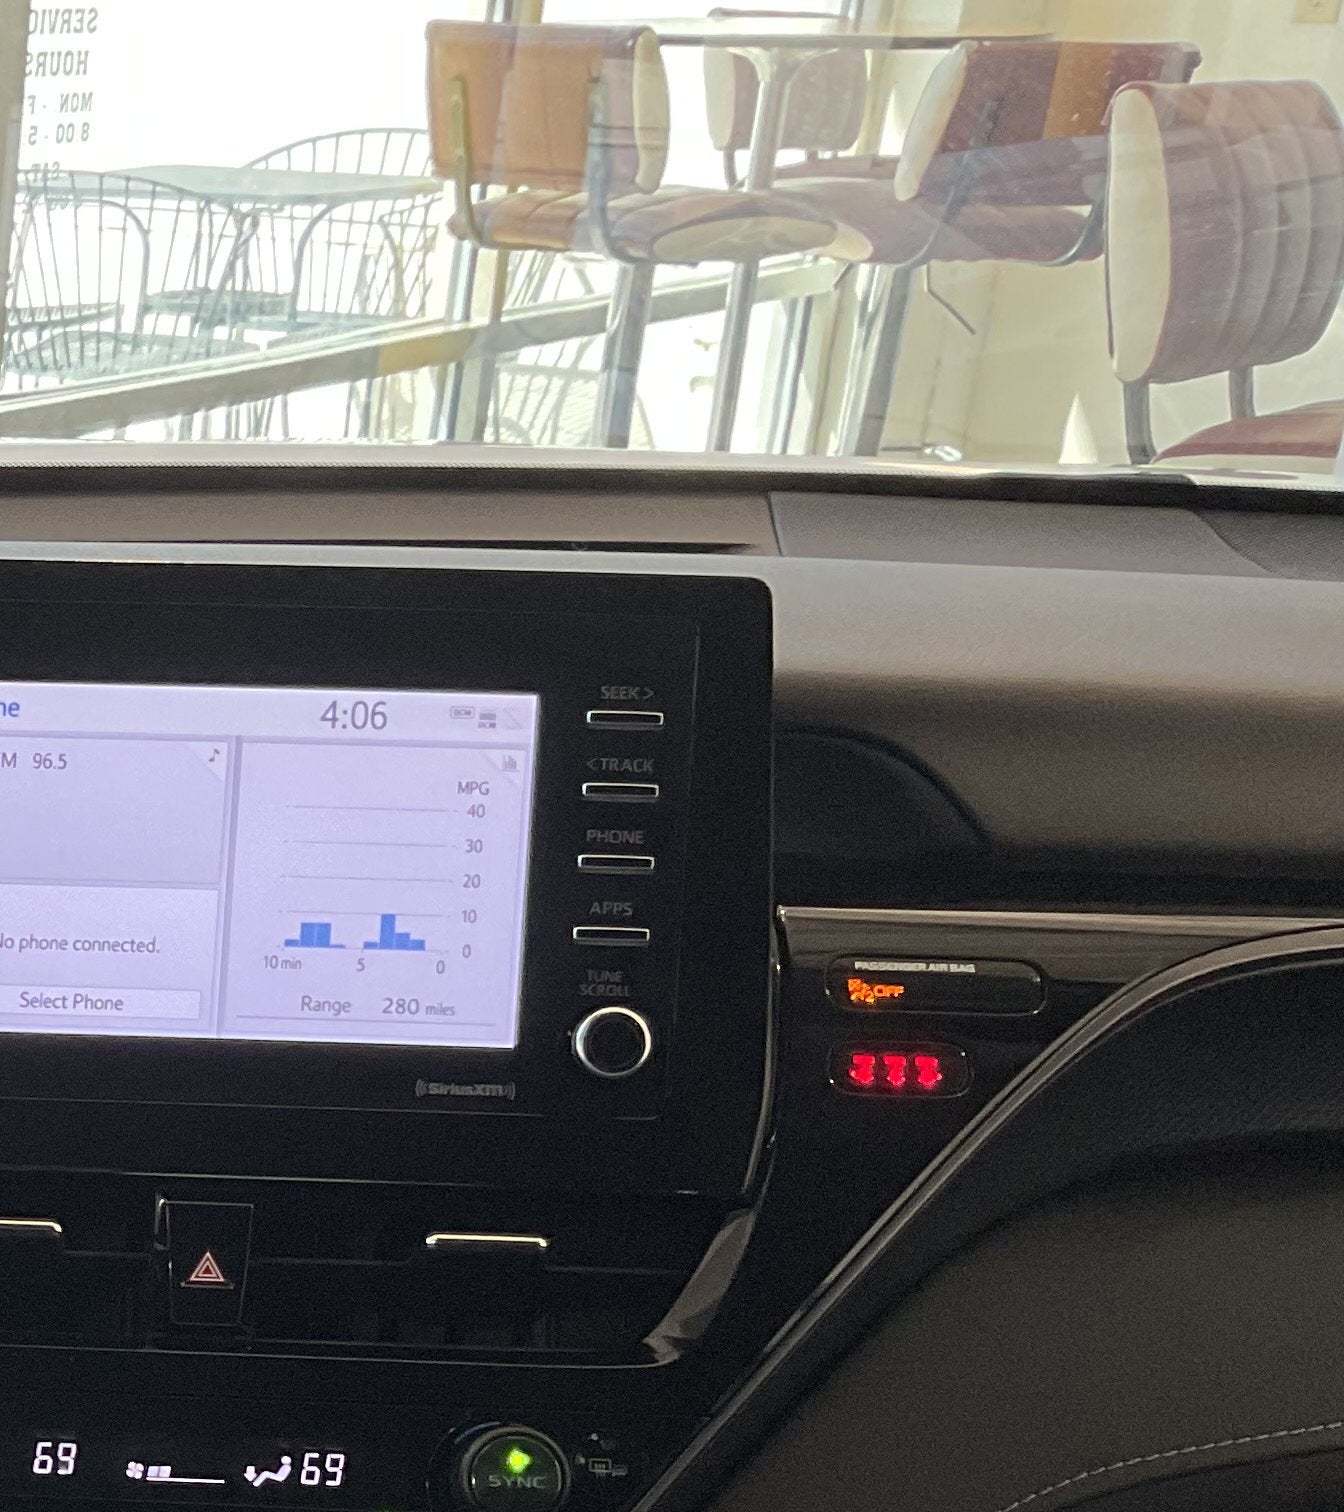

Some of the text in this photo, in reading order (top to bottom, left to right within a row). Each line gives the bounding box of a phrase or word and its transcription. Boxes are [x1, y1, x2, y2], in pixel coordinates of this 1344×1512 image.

[319, 700, 388, 731] 4:06
[32, 752, 68, 770] 96.5
[457, 780, 490, 797] MPG
[466, 804, 486, 818] 40
[586, 829, 645, 844] PHONE
[465, 839, 483, 853] 30
[462, 874, 481, 889] 20
[589, 902, 633, 916] APPS
[461, 910, 477, 924] 10
[19, 933, 69, 953] phone
[72, 935, 161, 954] connected.
[462, 944, 472, 959] 0
[263, 955, 303, 970] 10 min
[356, 958, 366, 973] 5
[436, 960, 446, 975] 0
[586, 969, 624, 983] TUNE
[578, 984, 630, 997] SCROLL
[19, 991, 124, 1012] Select Phone
[300, 994, 456, 1017] Range 280 miles
[32, 1440, 78, 1476] 69
[300, 1452, 347, 1487] 69
[487, 1474, 547, 1489] SYNC
